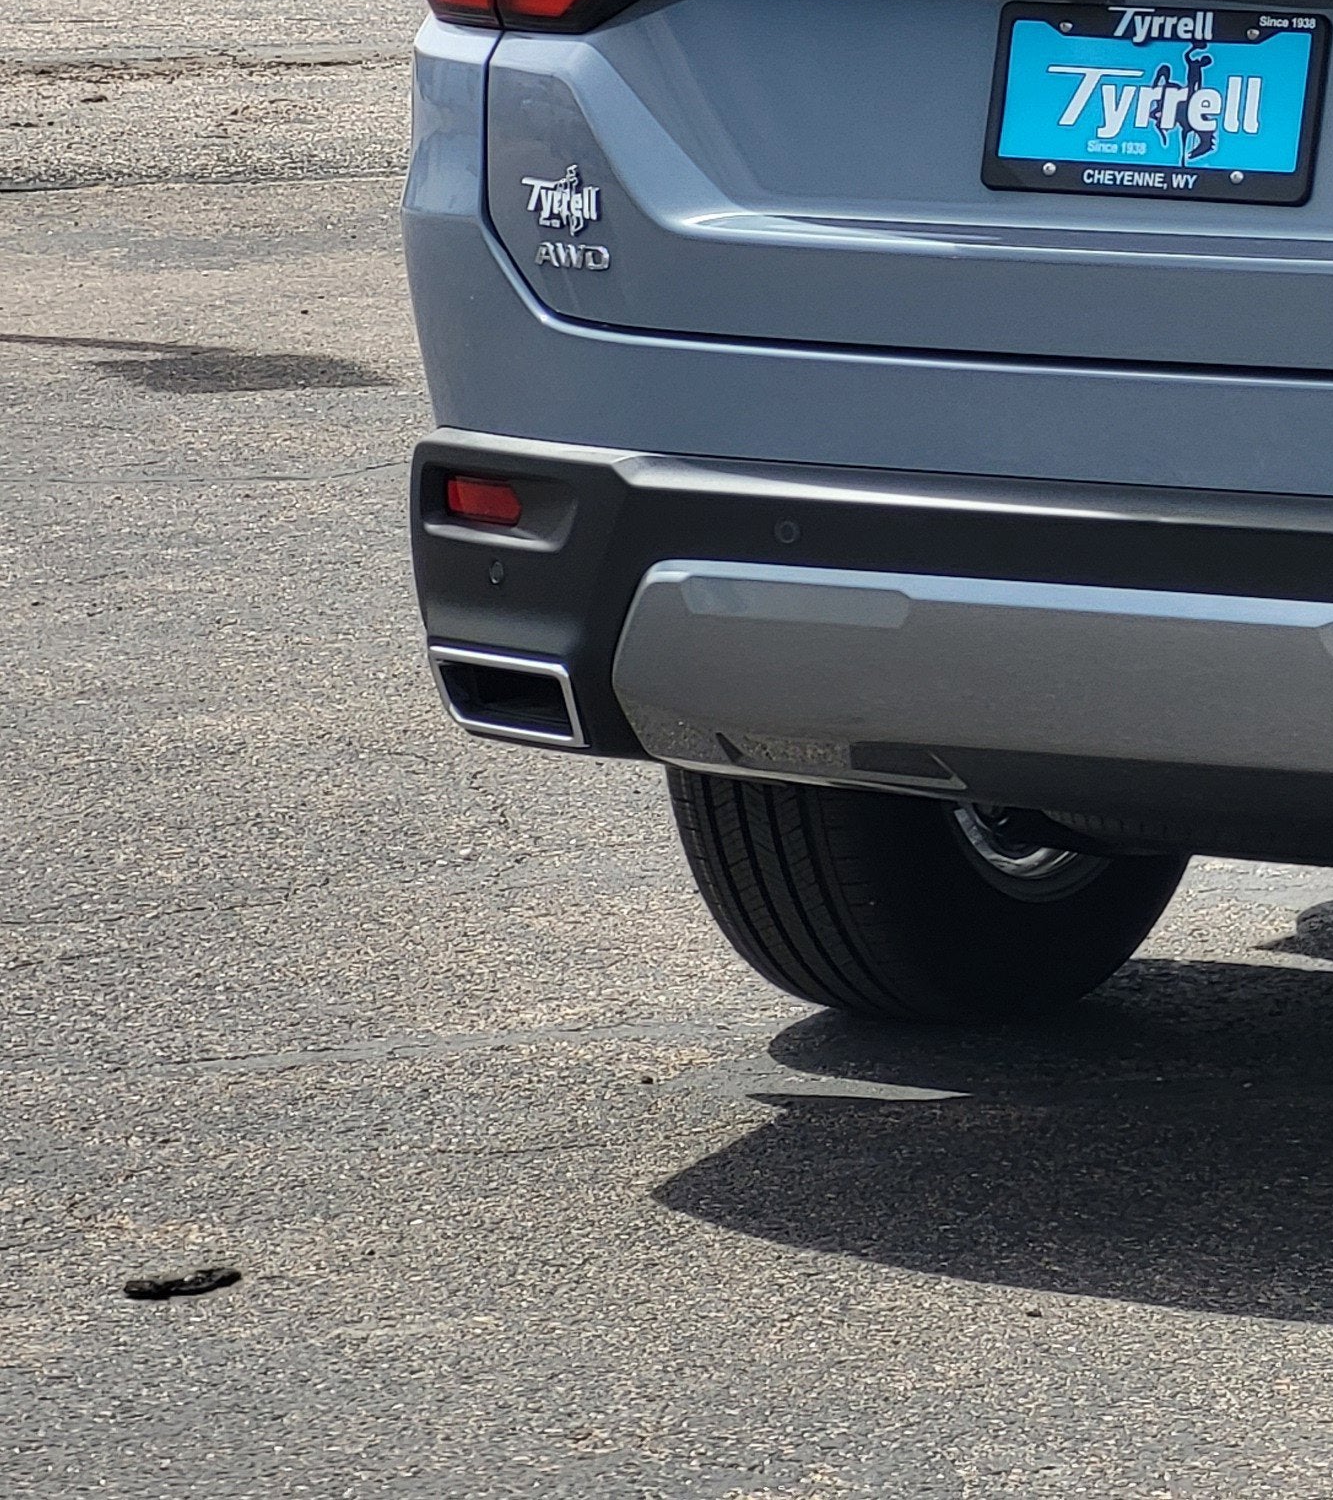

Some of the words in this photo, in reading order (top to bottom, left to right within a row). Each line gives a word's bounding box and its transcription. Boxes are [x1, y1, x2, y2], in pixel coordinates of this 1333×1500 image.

[1108, 6, 1214, 43] Tyrrell
[1259, 16, 1289, 28] Since
[1292, 17, 1316, 29] 1938
[1047, 65, 1262, 138] Tyrrell
[1087, 141, 1118, 155] Since
[1120, 142, 1147, 155] 1938
[1083, 170, 1168, 190] CHEYENNE,
[1172, 173, 1198, 189] WY
[521, 177, 600, 228] Tyrrell
[535, 241, 610, 270] AWD
